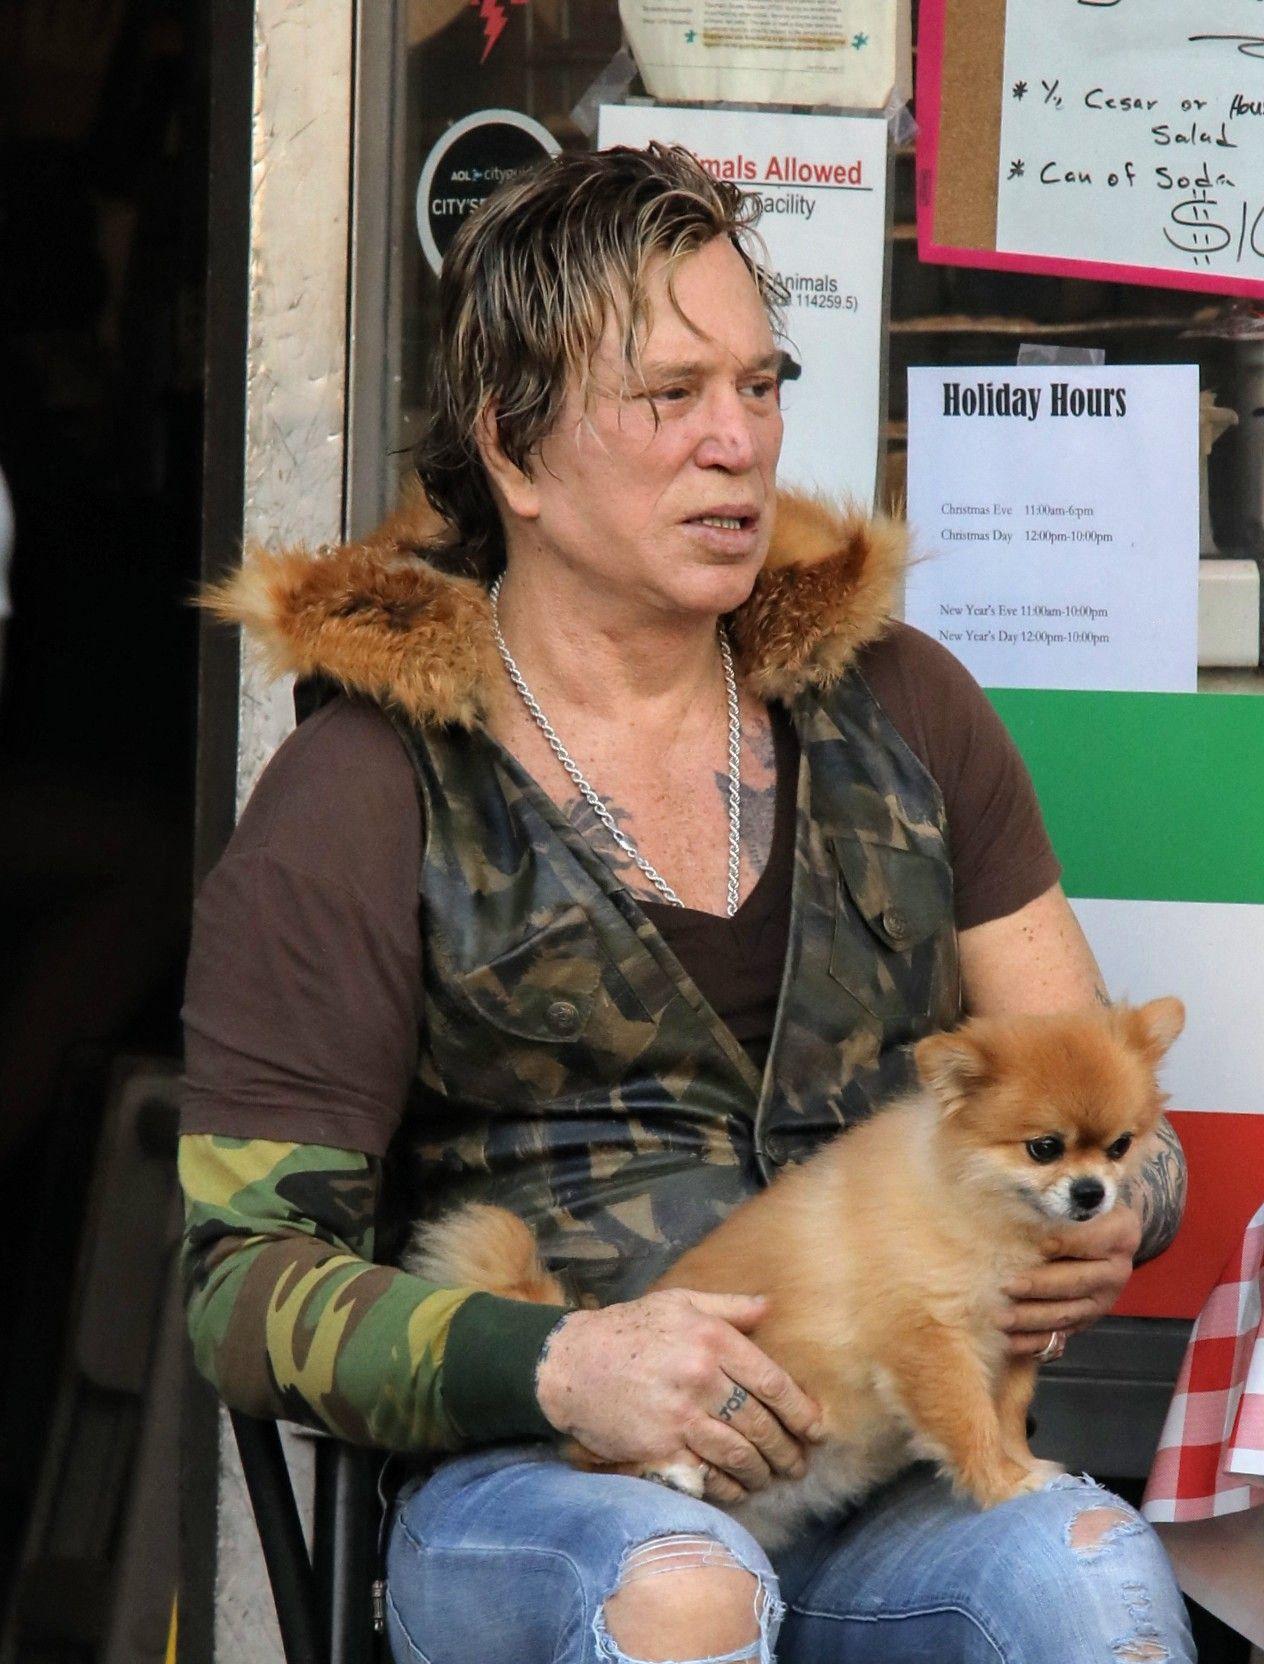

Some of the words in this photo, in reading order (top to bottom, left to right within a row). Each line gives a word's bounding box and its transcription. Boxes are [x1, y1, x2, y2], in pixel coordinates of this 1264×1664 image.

[1181, 99, 1207, 112] or
[1229, 93, 1264, 120] Hou
[1151, 122, 1238, 148] Salad
[450, 170, 471, 181] AOL
[764, 155, 863, 185] Allowed
[1040, 162, 1092, 184] Can
[1107, 162, 1136, 187] of
[943, 382, 1041, 421] Holiday
[1050, 382, 1127, 418] Hours
[941, 503, 990, 515] Christmas
[993, 503, 1013, 515] Eve
[941, 529, 990, 541] Christmas
[992, 529, 1013, 545] Day
[1025, 529, 1113, 546] 12:00pm-10:00pm
[940, 604, 963, 616] New
[966, 604, 996, 616] Year's
[999, 605, 1018, 617] Eve
[1021, 605, 1109, 621] 11:00am-10:00pm
[939, 630, 963, 642] New
[966, 630, 996, 643] Year's
[998, 630, 1018, 646] Day
[1021, 631, 1110, 647] 12:00pm-10:00pm
